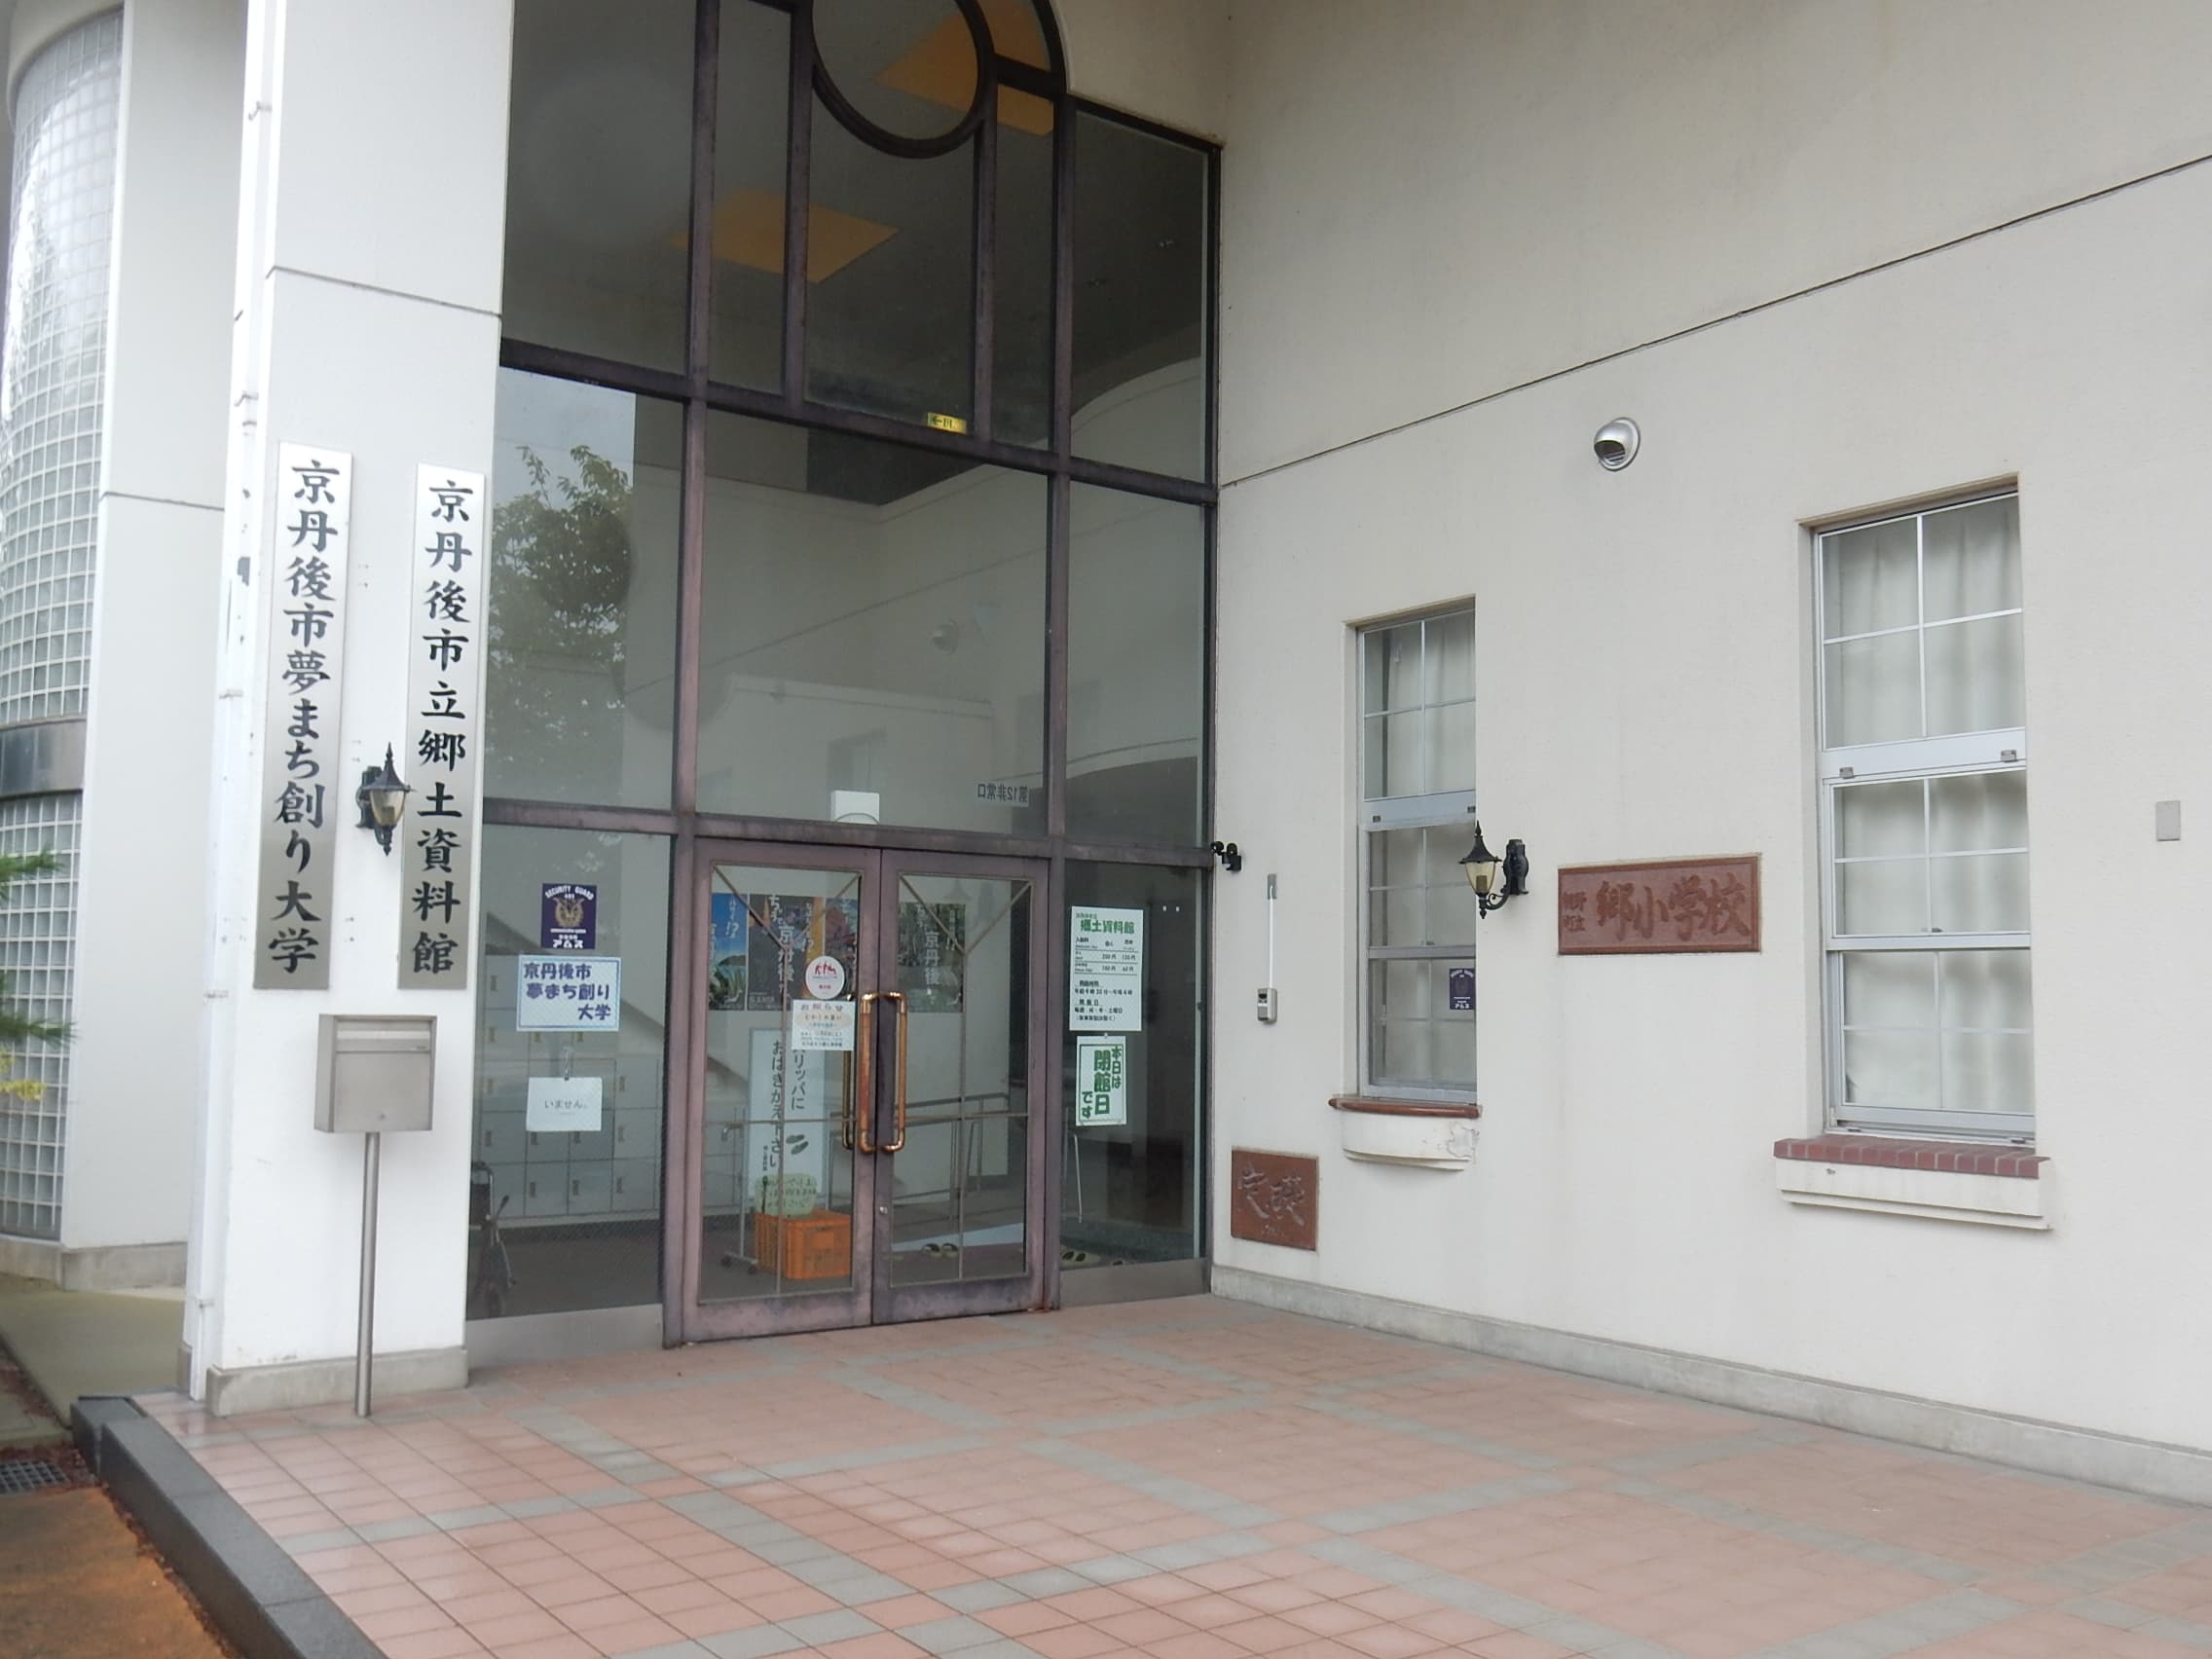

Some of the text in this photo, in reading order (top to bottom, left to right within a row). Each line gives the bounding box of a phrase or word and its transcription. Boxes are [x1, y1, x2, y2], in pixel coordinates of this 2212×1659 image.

[268, 460, 340, 975] 京丹後市夢まち創り大学
[411, 479, 473, 976] 京丹後市立郷土資料館
[545, 885, 594, 901] SECURITY GUARD
[1081, 919, 1134, 934] 郷土資料館
[524, 962, 592, 980] 京丹後市
[527, 982, 609, 1000] 夢まち創り
[577, 1004, 610, 1020] 大学
[1112, 1045, 1122, 1088] 本日は
[792, 1049, 807, 1111] リッパに
[1082, 1091, 1092, 1119] です
